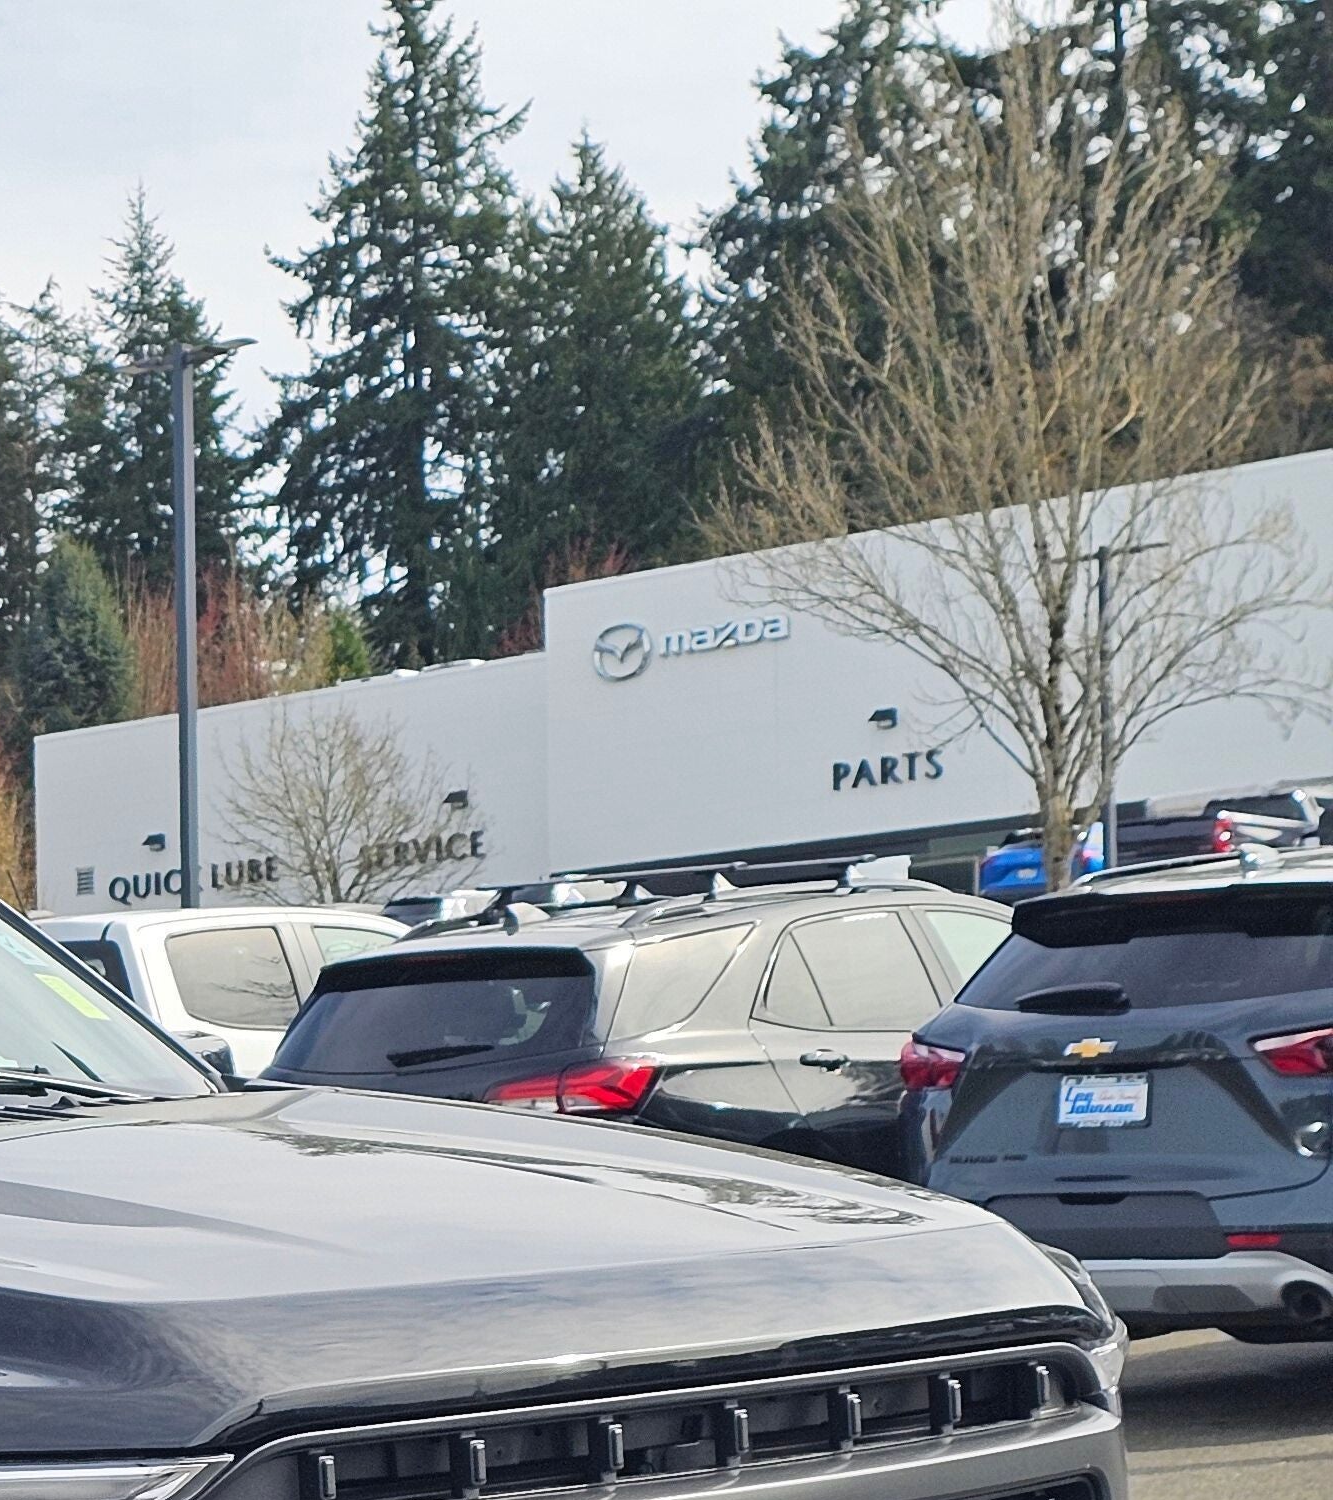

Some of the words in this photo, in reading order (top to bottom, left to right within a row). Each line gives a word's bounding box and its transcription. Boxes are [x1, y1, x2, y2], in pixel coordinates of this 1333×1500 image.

[658, 614, 790, 657] mazda
[832, 749, 944, 791] PARTS
[359, 830, 487, 870] SERVICE
[108, 868, 203, 905] QUIC
[211, 856, 280, 890] LUBE
